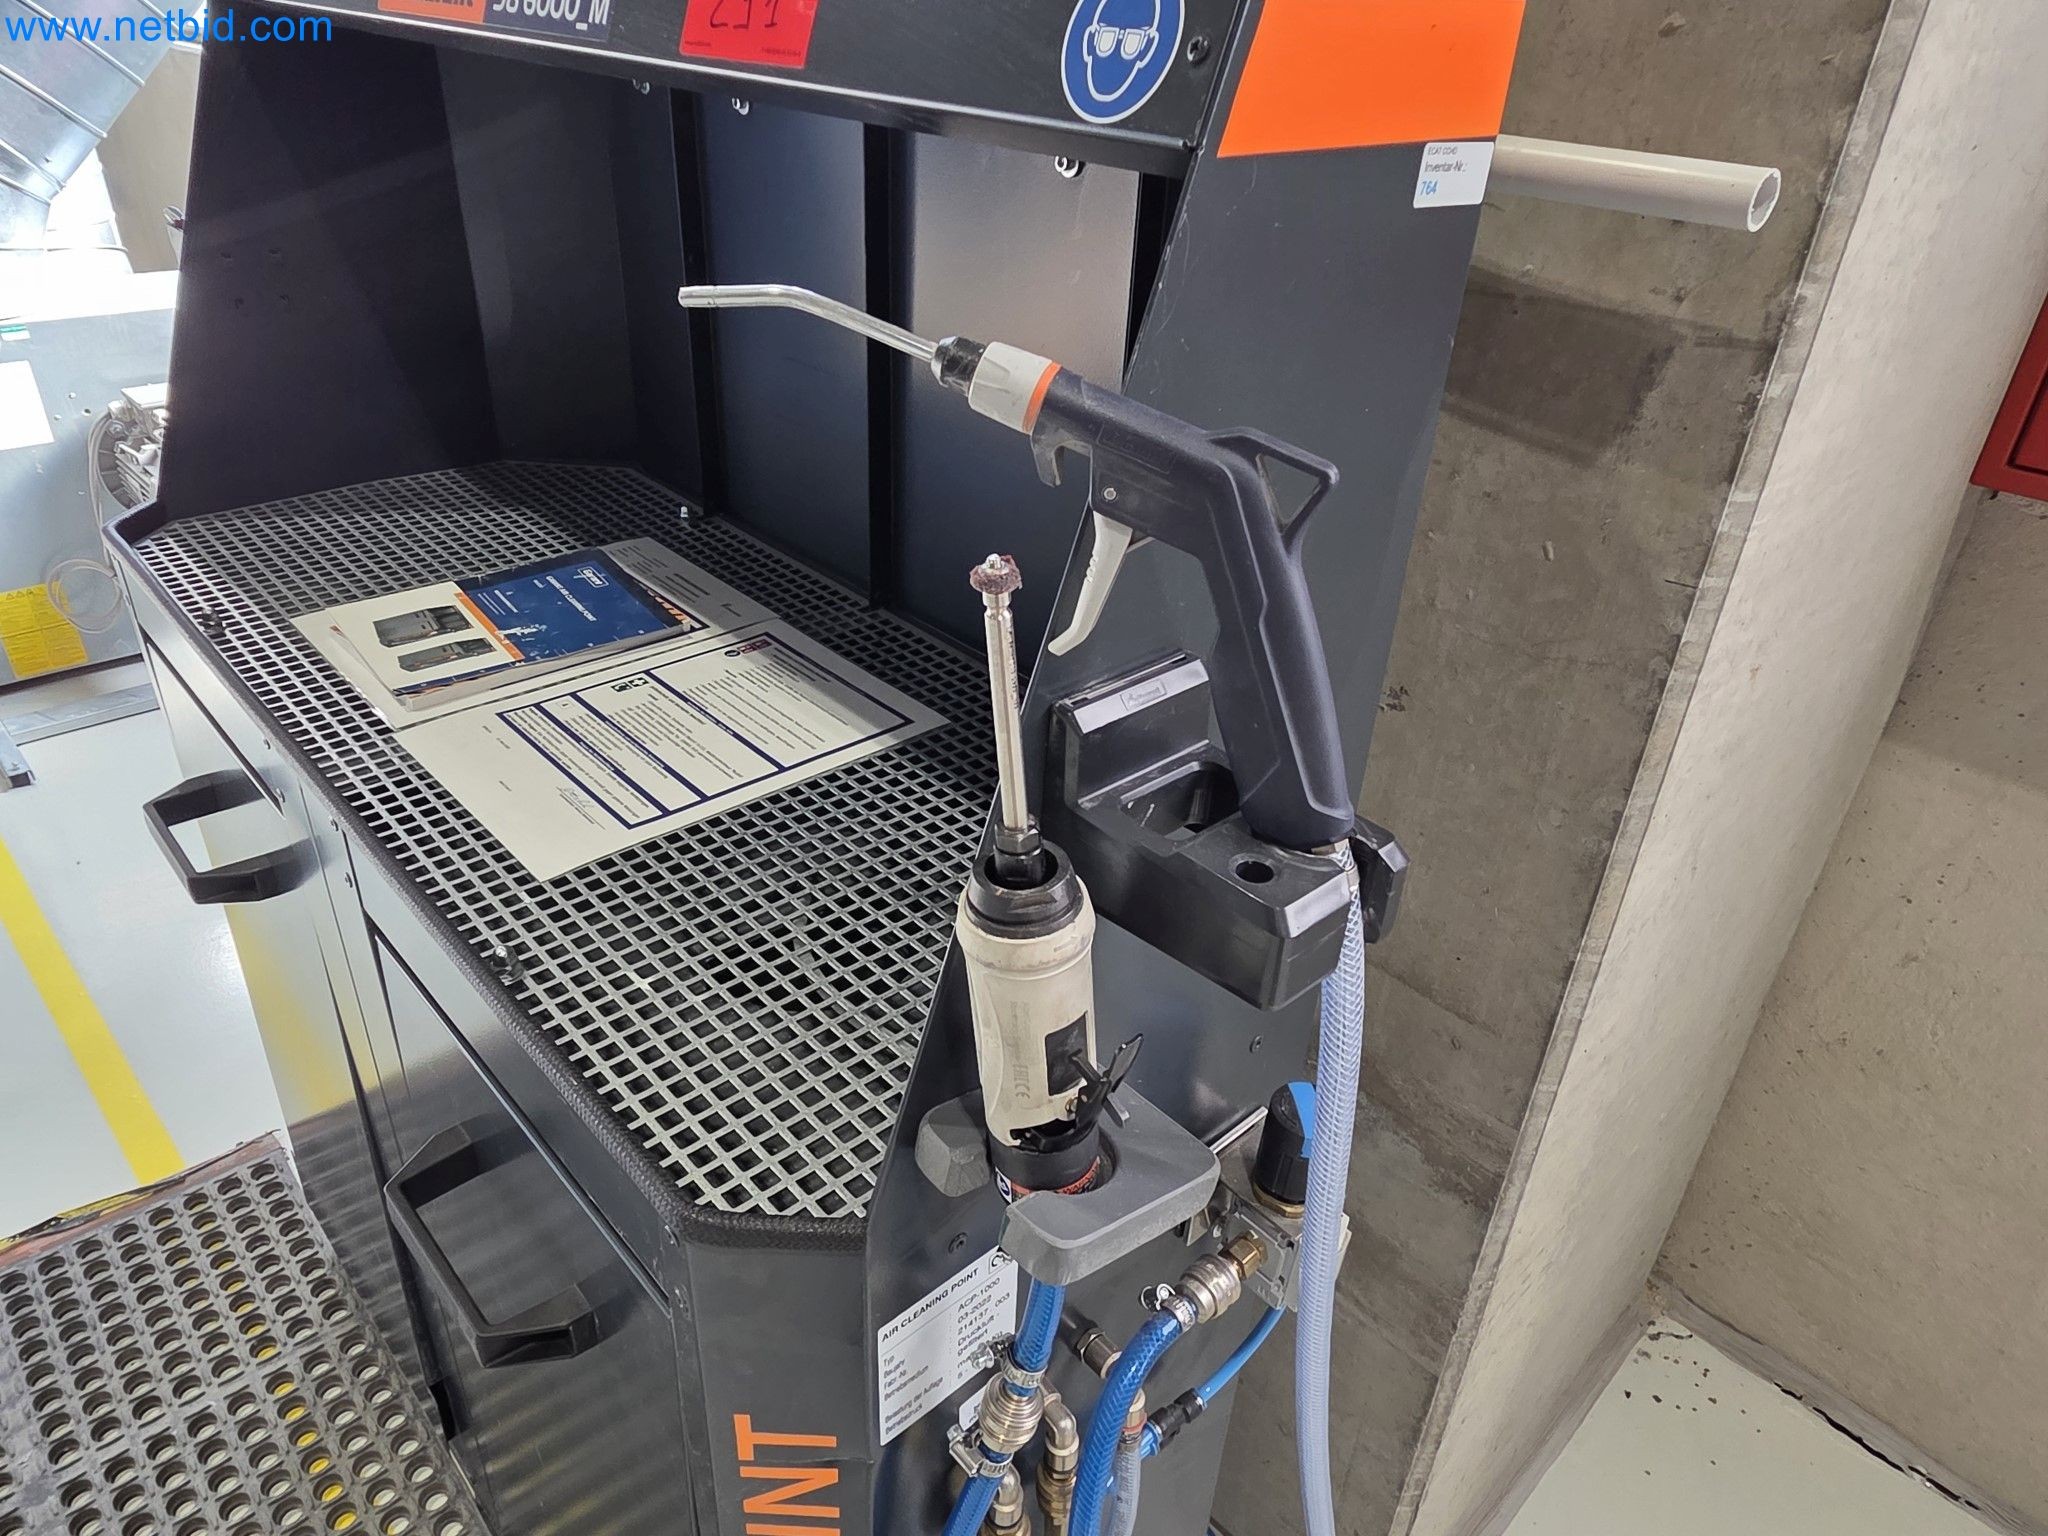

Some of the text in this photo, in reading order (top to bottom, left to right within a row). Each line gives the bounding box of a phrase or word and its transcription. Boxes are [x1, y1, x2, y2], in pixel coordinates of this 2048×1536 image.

[881, 1267, 979, 1342] AIR CLEANING POINT
